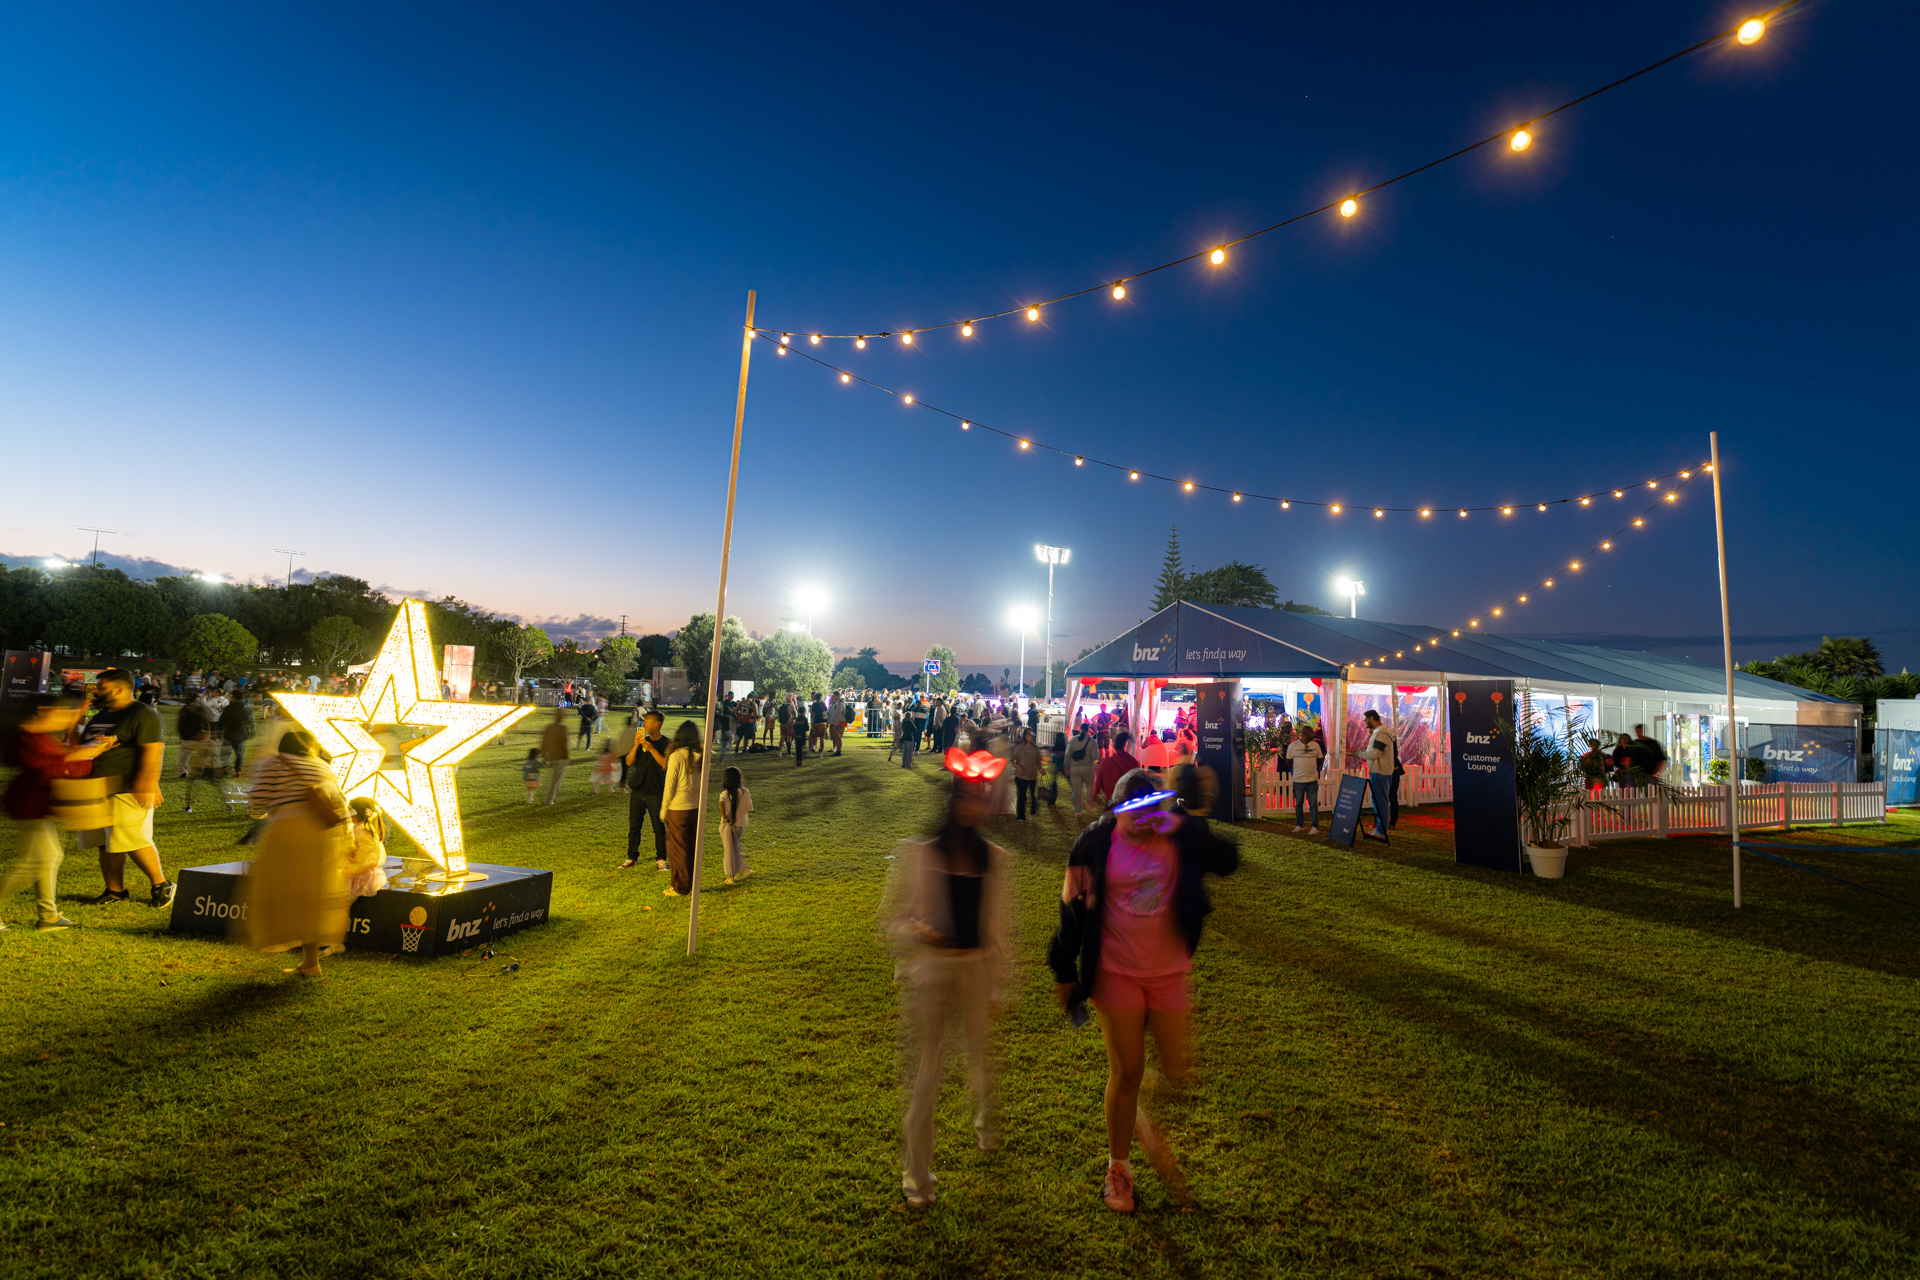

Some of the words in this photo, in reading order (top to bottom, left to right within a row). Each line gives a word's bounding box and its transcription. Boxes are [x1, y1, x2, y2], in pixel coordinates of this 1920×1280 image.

[1133, 643, 1160, 661] bnz
[1186, 649, 1200, 660] let's
[1202, 648, 1220, 662] find
[1228, 650, 1246, 661] way
[1205, 720, 1218, 729] bnz
[1466, 732, 1490, 744] bnz
[1462, 753, 1500, 762] Customer
[1763, 745, 1804, 762] bnz
[1468, 762, 1496, 773] Lounge
[1778, 763, 1794, 772] find
[1892, 753, 1912, 771] bnz
[194, 895, 248, 920] Shoot
[446, 918, 482, 942] bnz
[492, 918, 508, 930] let's
[508, 910, 524, 928] find
[524, 912, 530, 920] a
[530, 908, 544, 920] way
